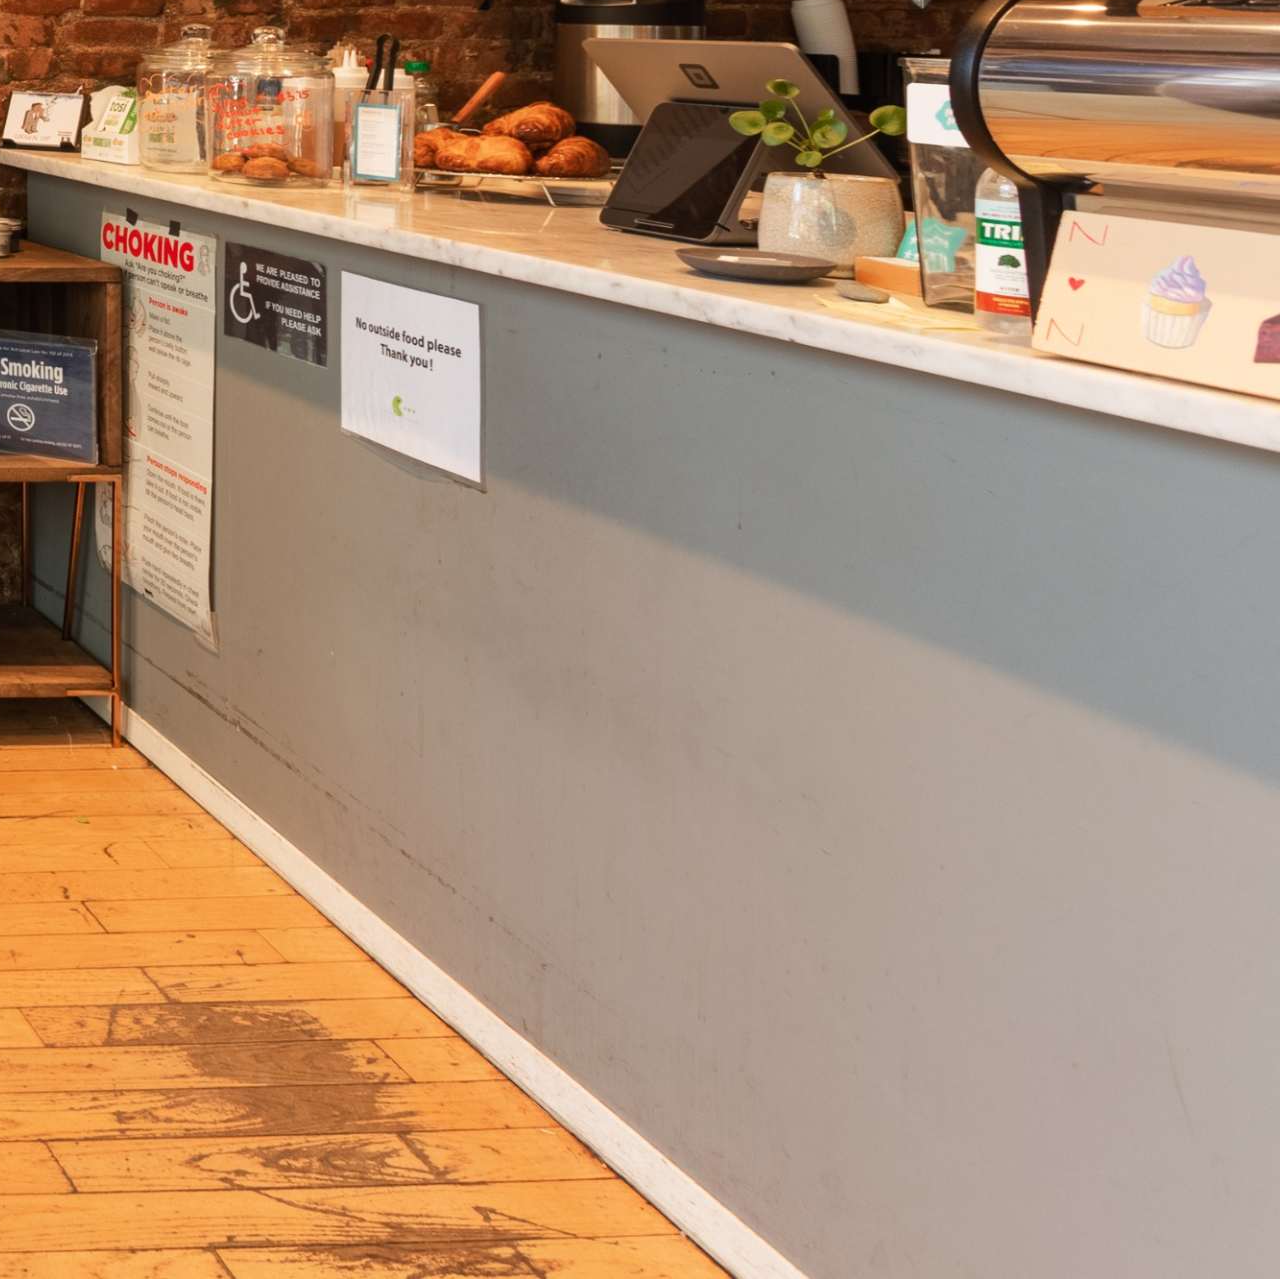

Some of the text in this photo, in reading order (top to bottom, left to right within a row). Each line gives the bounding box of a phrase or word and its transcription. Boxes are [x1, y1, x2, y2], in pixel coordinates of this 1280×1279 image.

[981, 222, 1024, 241] TRI
[102, 222, 194, 272] CHOKING
[125, 260, 134, 268] Ask
[256, 263, 320, 287] WE ARE PLEASED TO
[147, 277, 160, 288] can't
[161, 281, 176, 293] speak
[178, 286, 184, 294] or
[186, 287, 208, 303] breathe
[256, 275, 320, 300] PROVIDE ASSISTANCE
[149, 297, 166, 309] Person
[265, 301, 321, 323] IF YOU NEED HELP
[281, 317, 321, 336] PLEASE ASK
[355, 317, 462, 358] No outside food please
[380, 343, 408, 363] Thank
[0, 357, 63, 384] Smoking
[20, 381, 52, 394] Cigarette
[54, 386, 68, 396] Use
